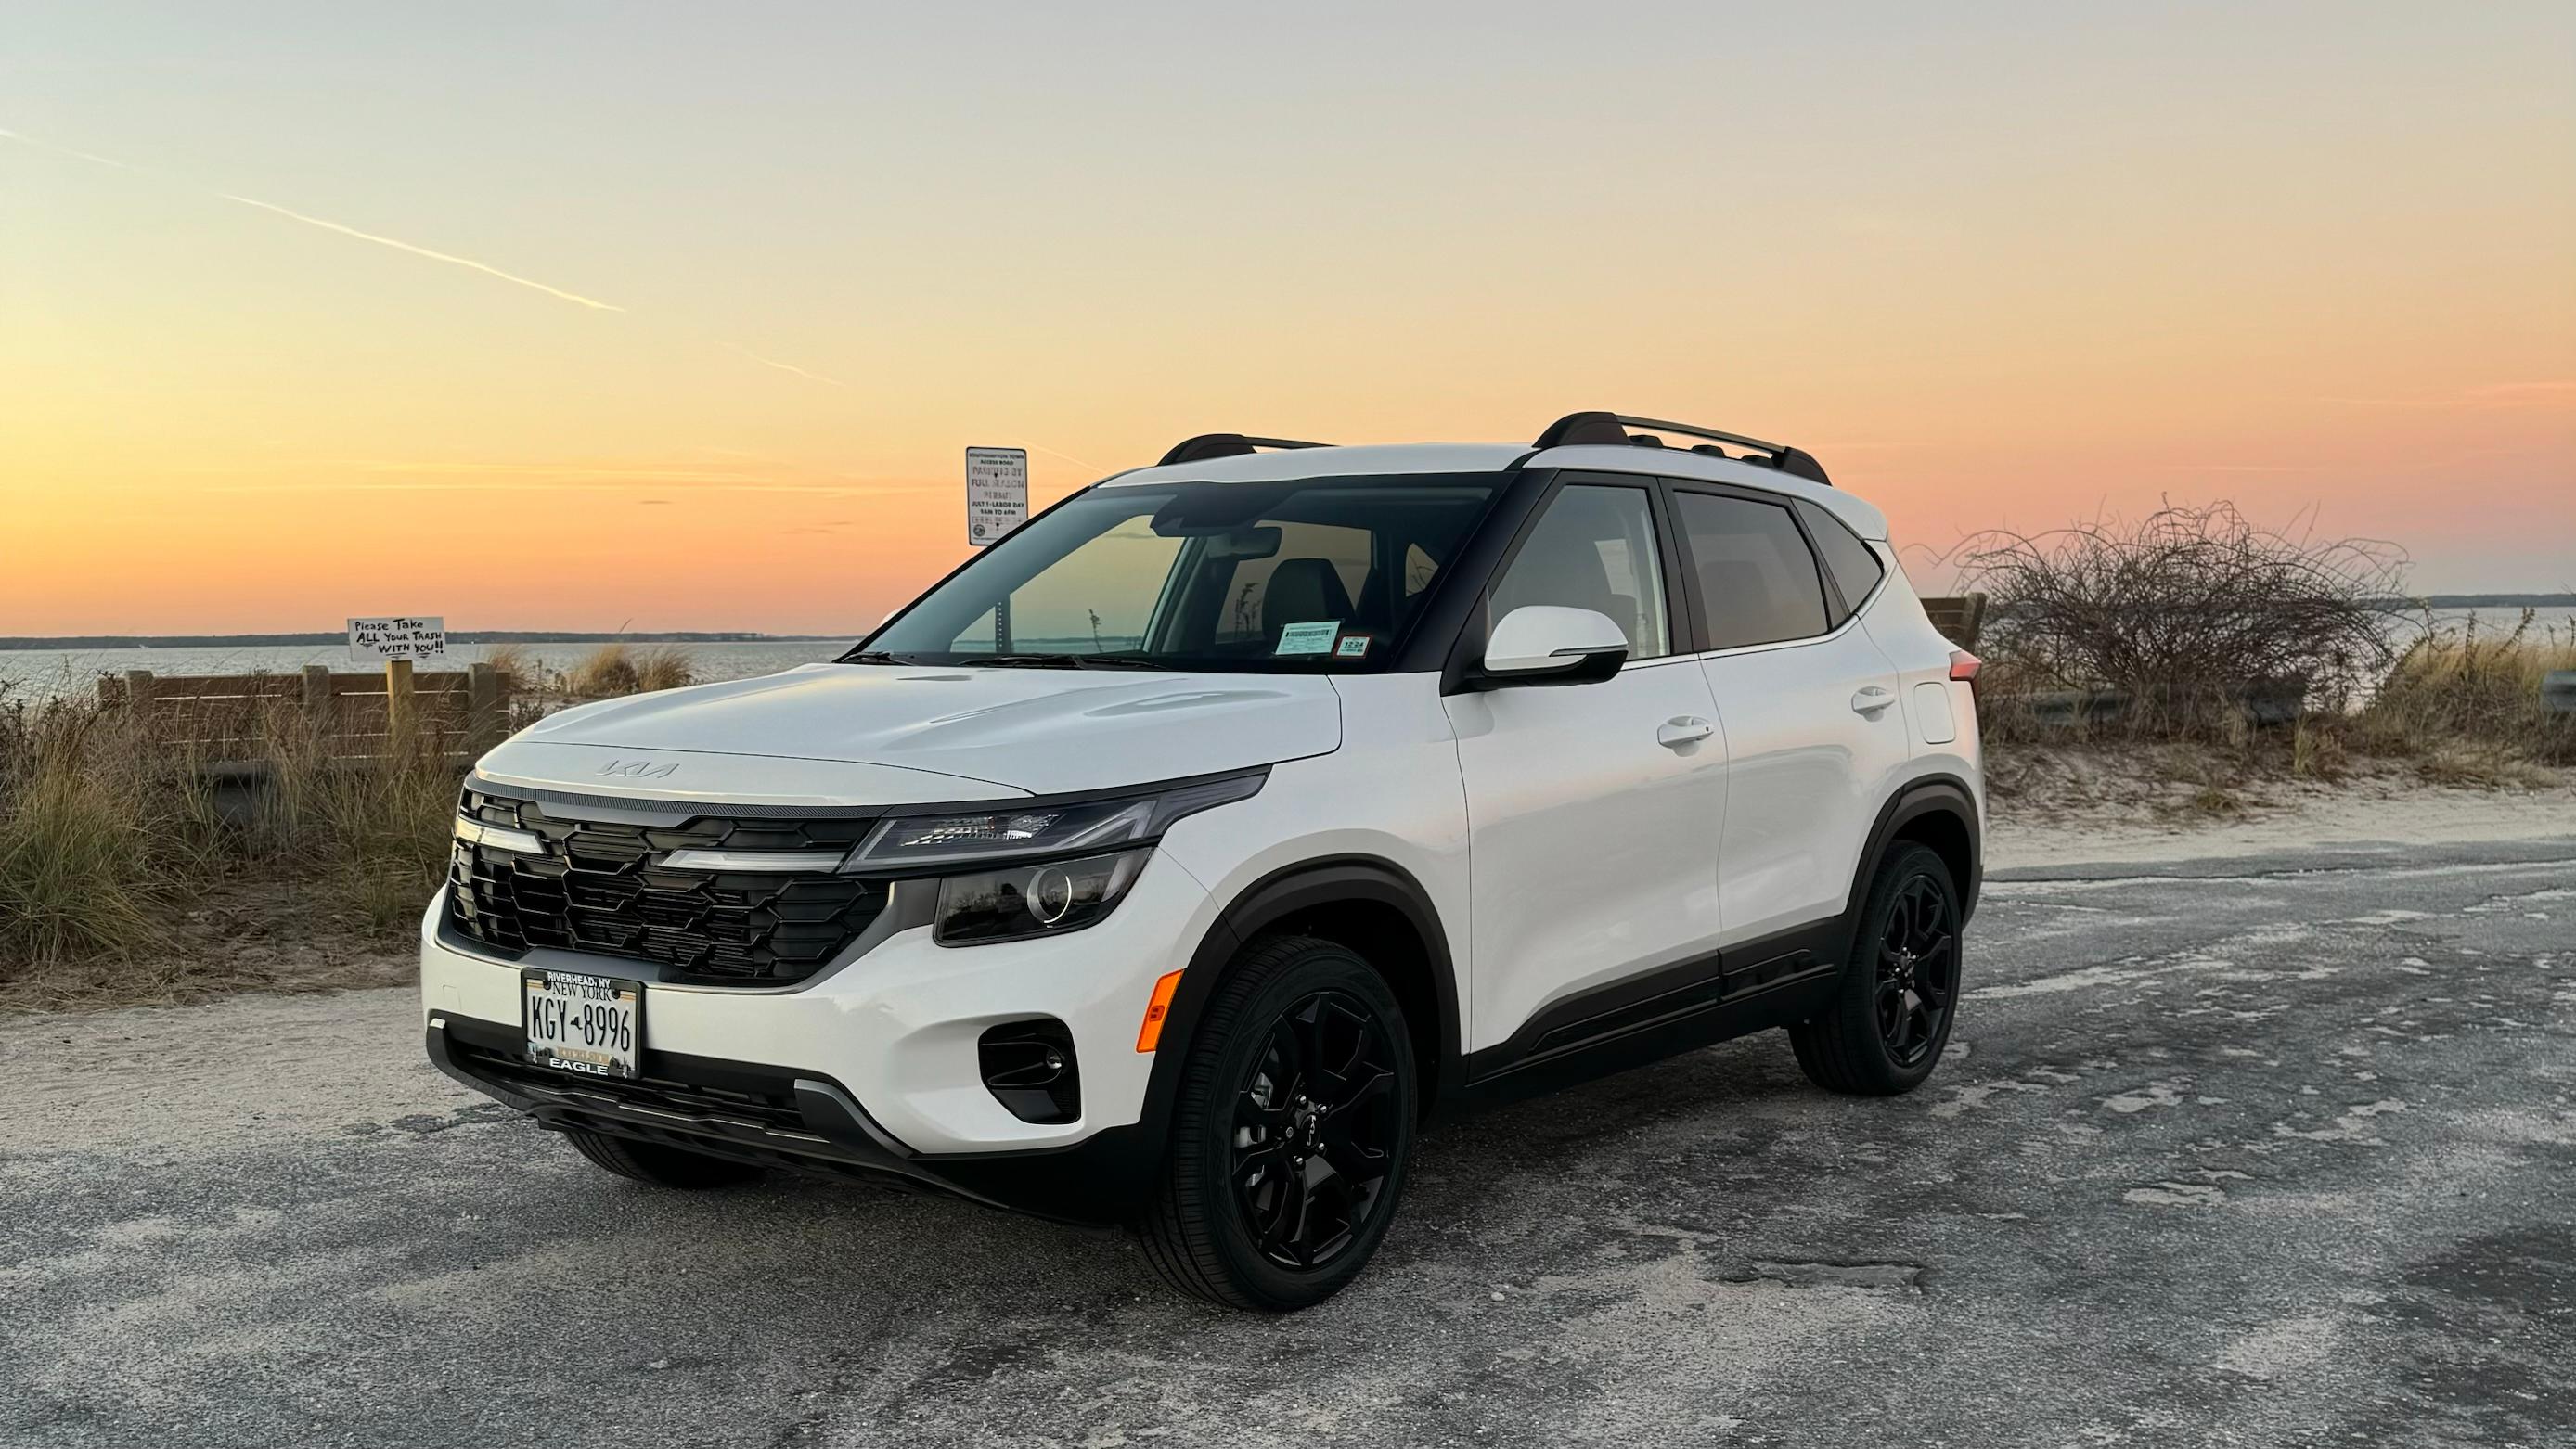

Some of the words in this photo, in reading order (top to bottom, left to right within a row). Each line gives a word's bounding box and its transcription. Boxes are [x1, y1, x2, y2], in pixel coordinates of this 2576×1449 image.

[354, 622, 390, 631] Please
[393, 619, 423, 630] Take
[356, 632, 380, 643] ALL
[384, 633, 409, 641] YOUR
[412, 631, 442, 641] TRASH
[379, 644, 410, 653] WITH
[414, 640, 444, 654] YOU!!
[547, 971, 598, 987] RIVERHEAD,
[599, 978, 611, 988] NY
[553, 983, 577, 997] NEW
[581, 984, 612, 1002] YORK
[532, 995, 568, 1043] KGY
[583, 1004, 631, 1053] 8996
[549, 1058, 609, 1076] EAGLE
